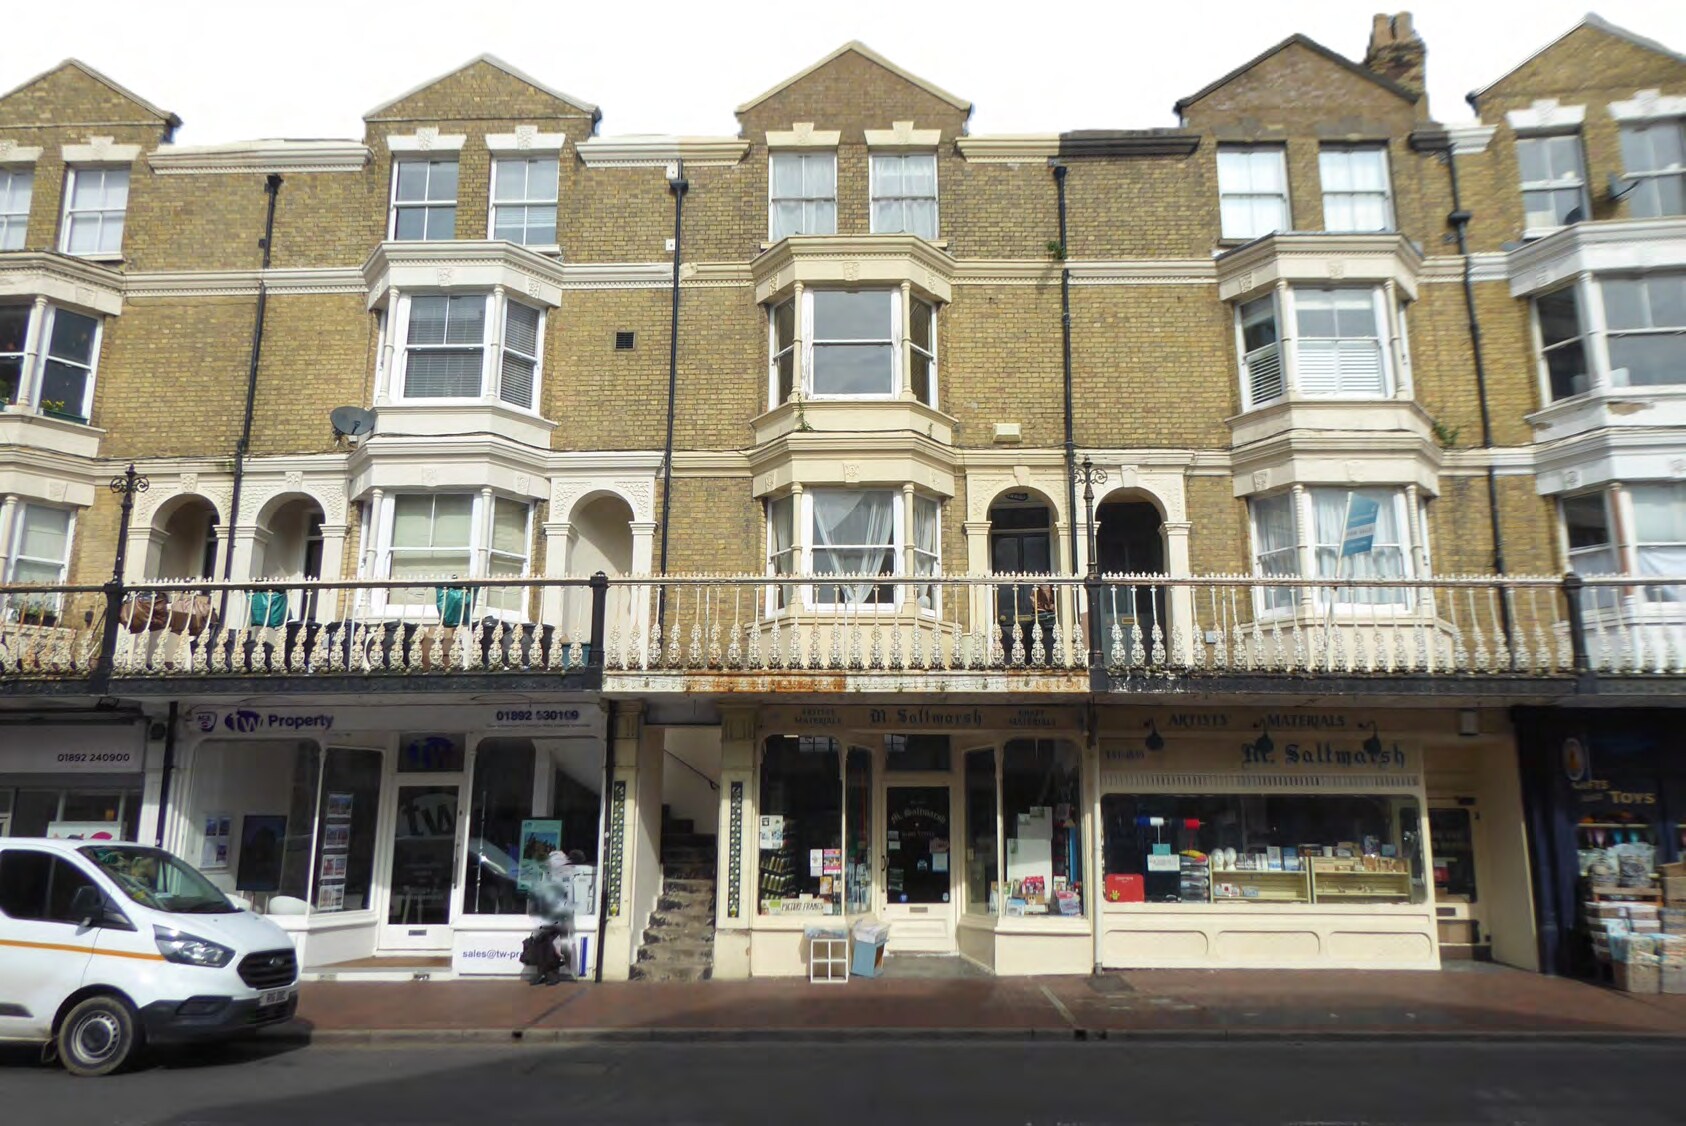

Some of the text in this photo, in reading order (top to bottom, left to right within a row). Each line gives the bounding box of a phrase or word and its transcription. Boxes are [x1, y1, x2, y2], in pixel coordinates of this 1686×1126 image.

[268, 714, 334, 730] Property
[496, 710, 532, 721] 01892
[896, 706, 982, 727] Saltmarsh
[1267, 714, 1345, 730] MATERIALS
[57, 753, 130, 762] 01892 240900
[1606, 791, 1656, 804] TOYS
